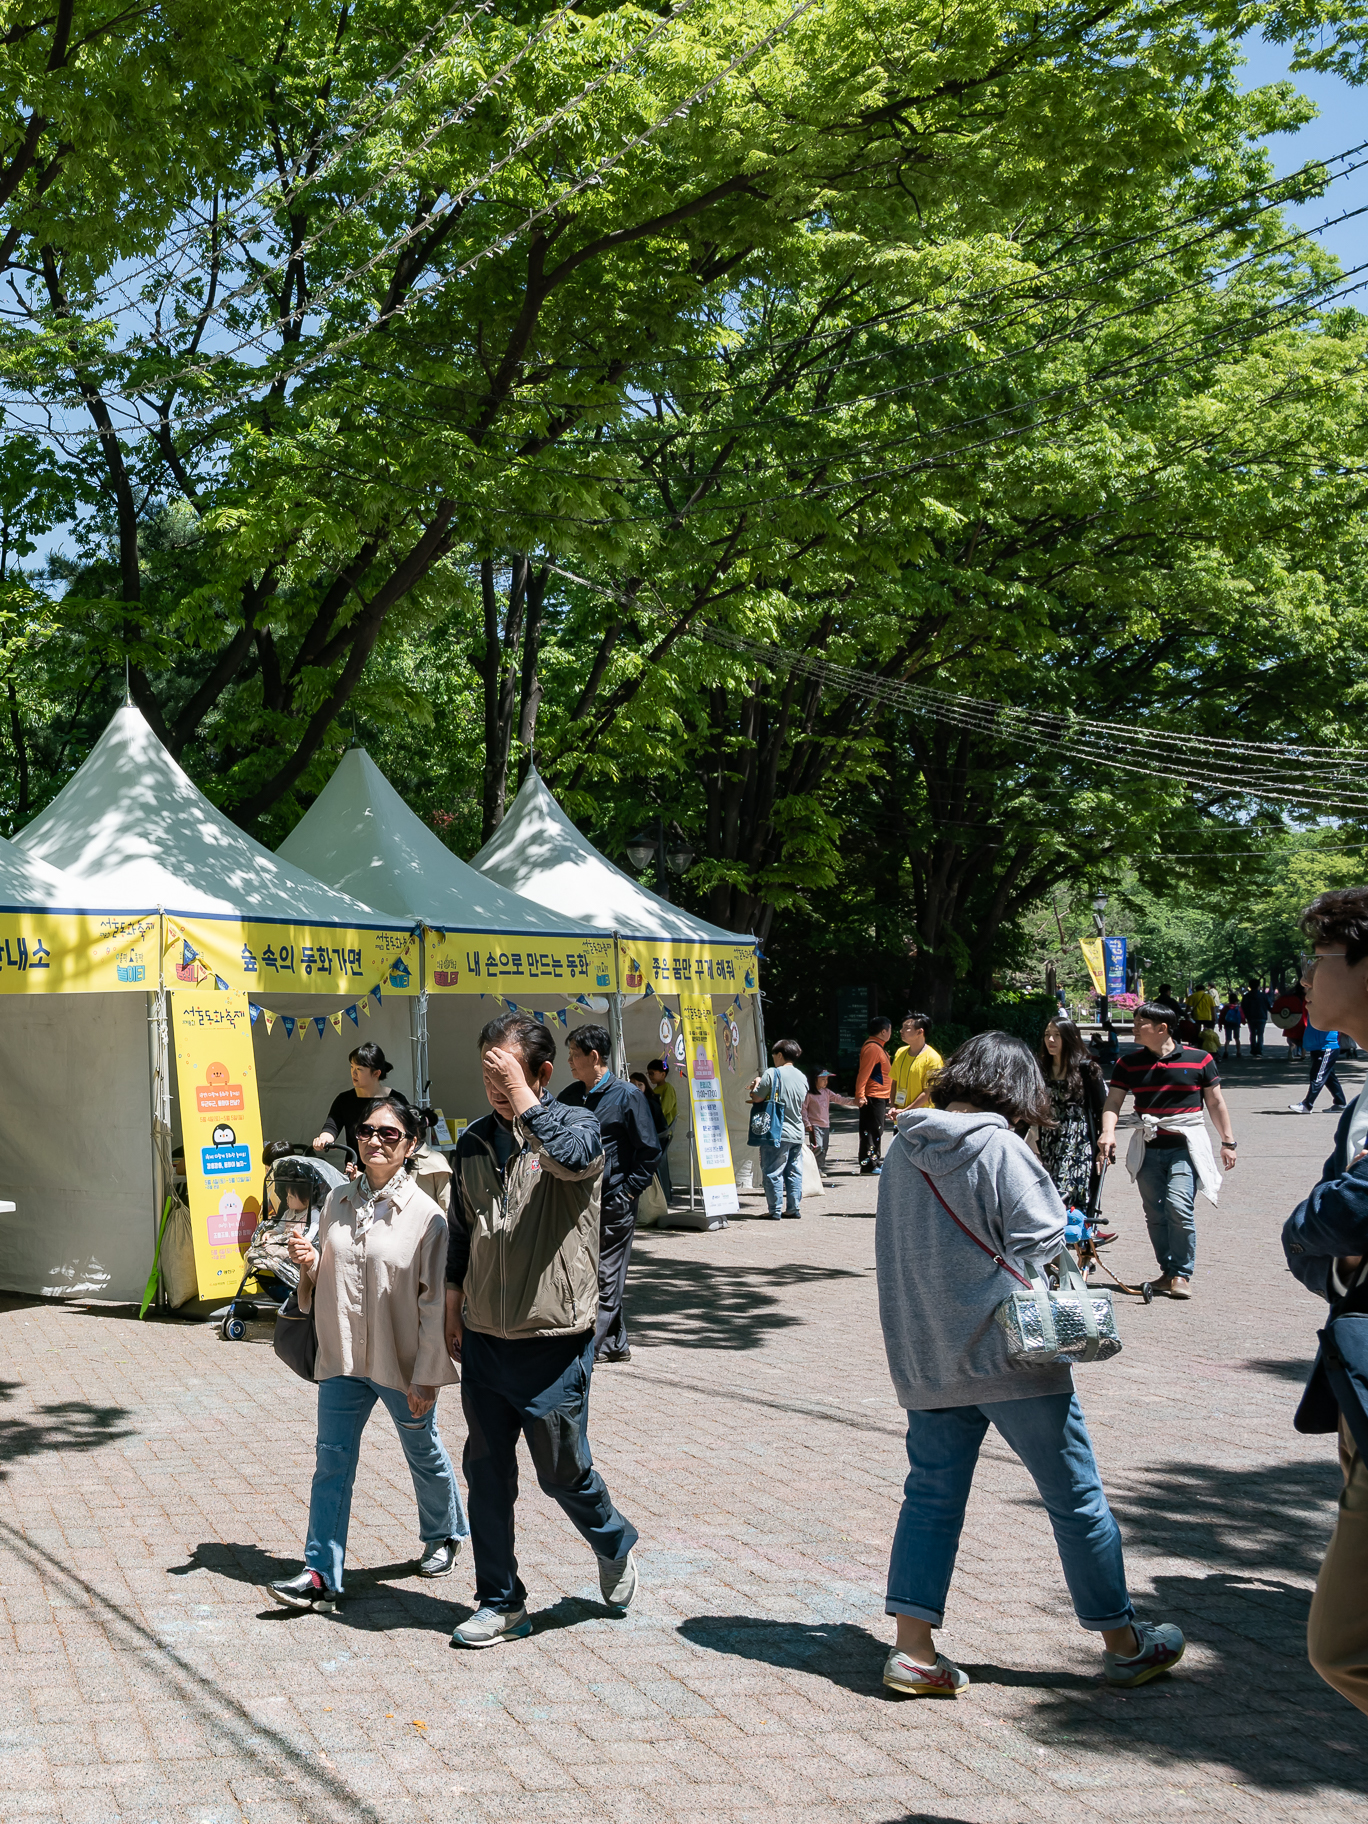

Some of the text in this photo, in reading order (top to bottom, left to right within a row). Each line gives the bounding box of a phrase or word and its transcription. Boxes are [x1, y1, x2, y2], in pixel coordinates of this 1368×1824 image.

[241, 942, 363, 976] 숲 속의 동화가면
[466, 951, 589, 978] 내 손으로 만드는 동화
[652, 957, 735, 981] 좋은 꿈만 꾸게 해줘
[183, 1006, 245, 1029] 서울동화축제
